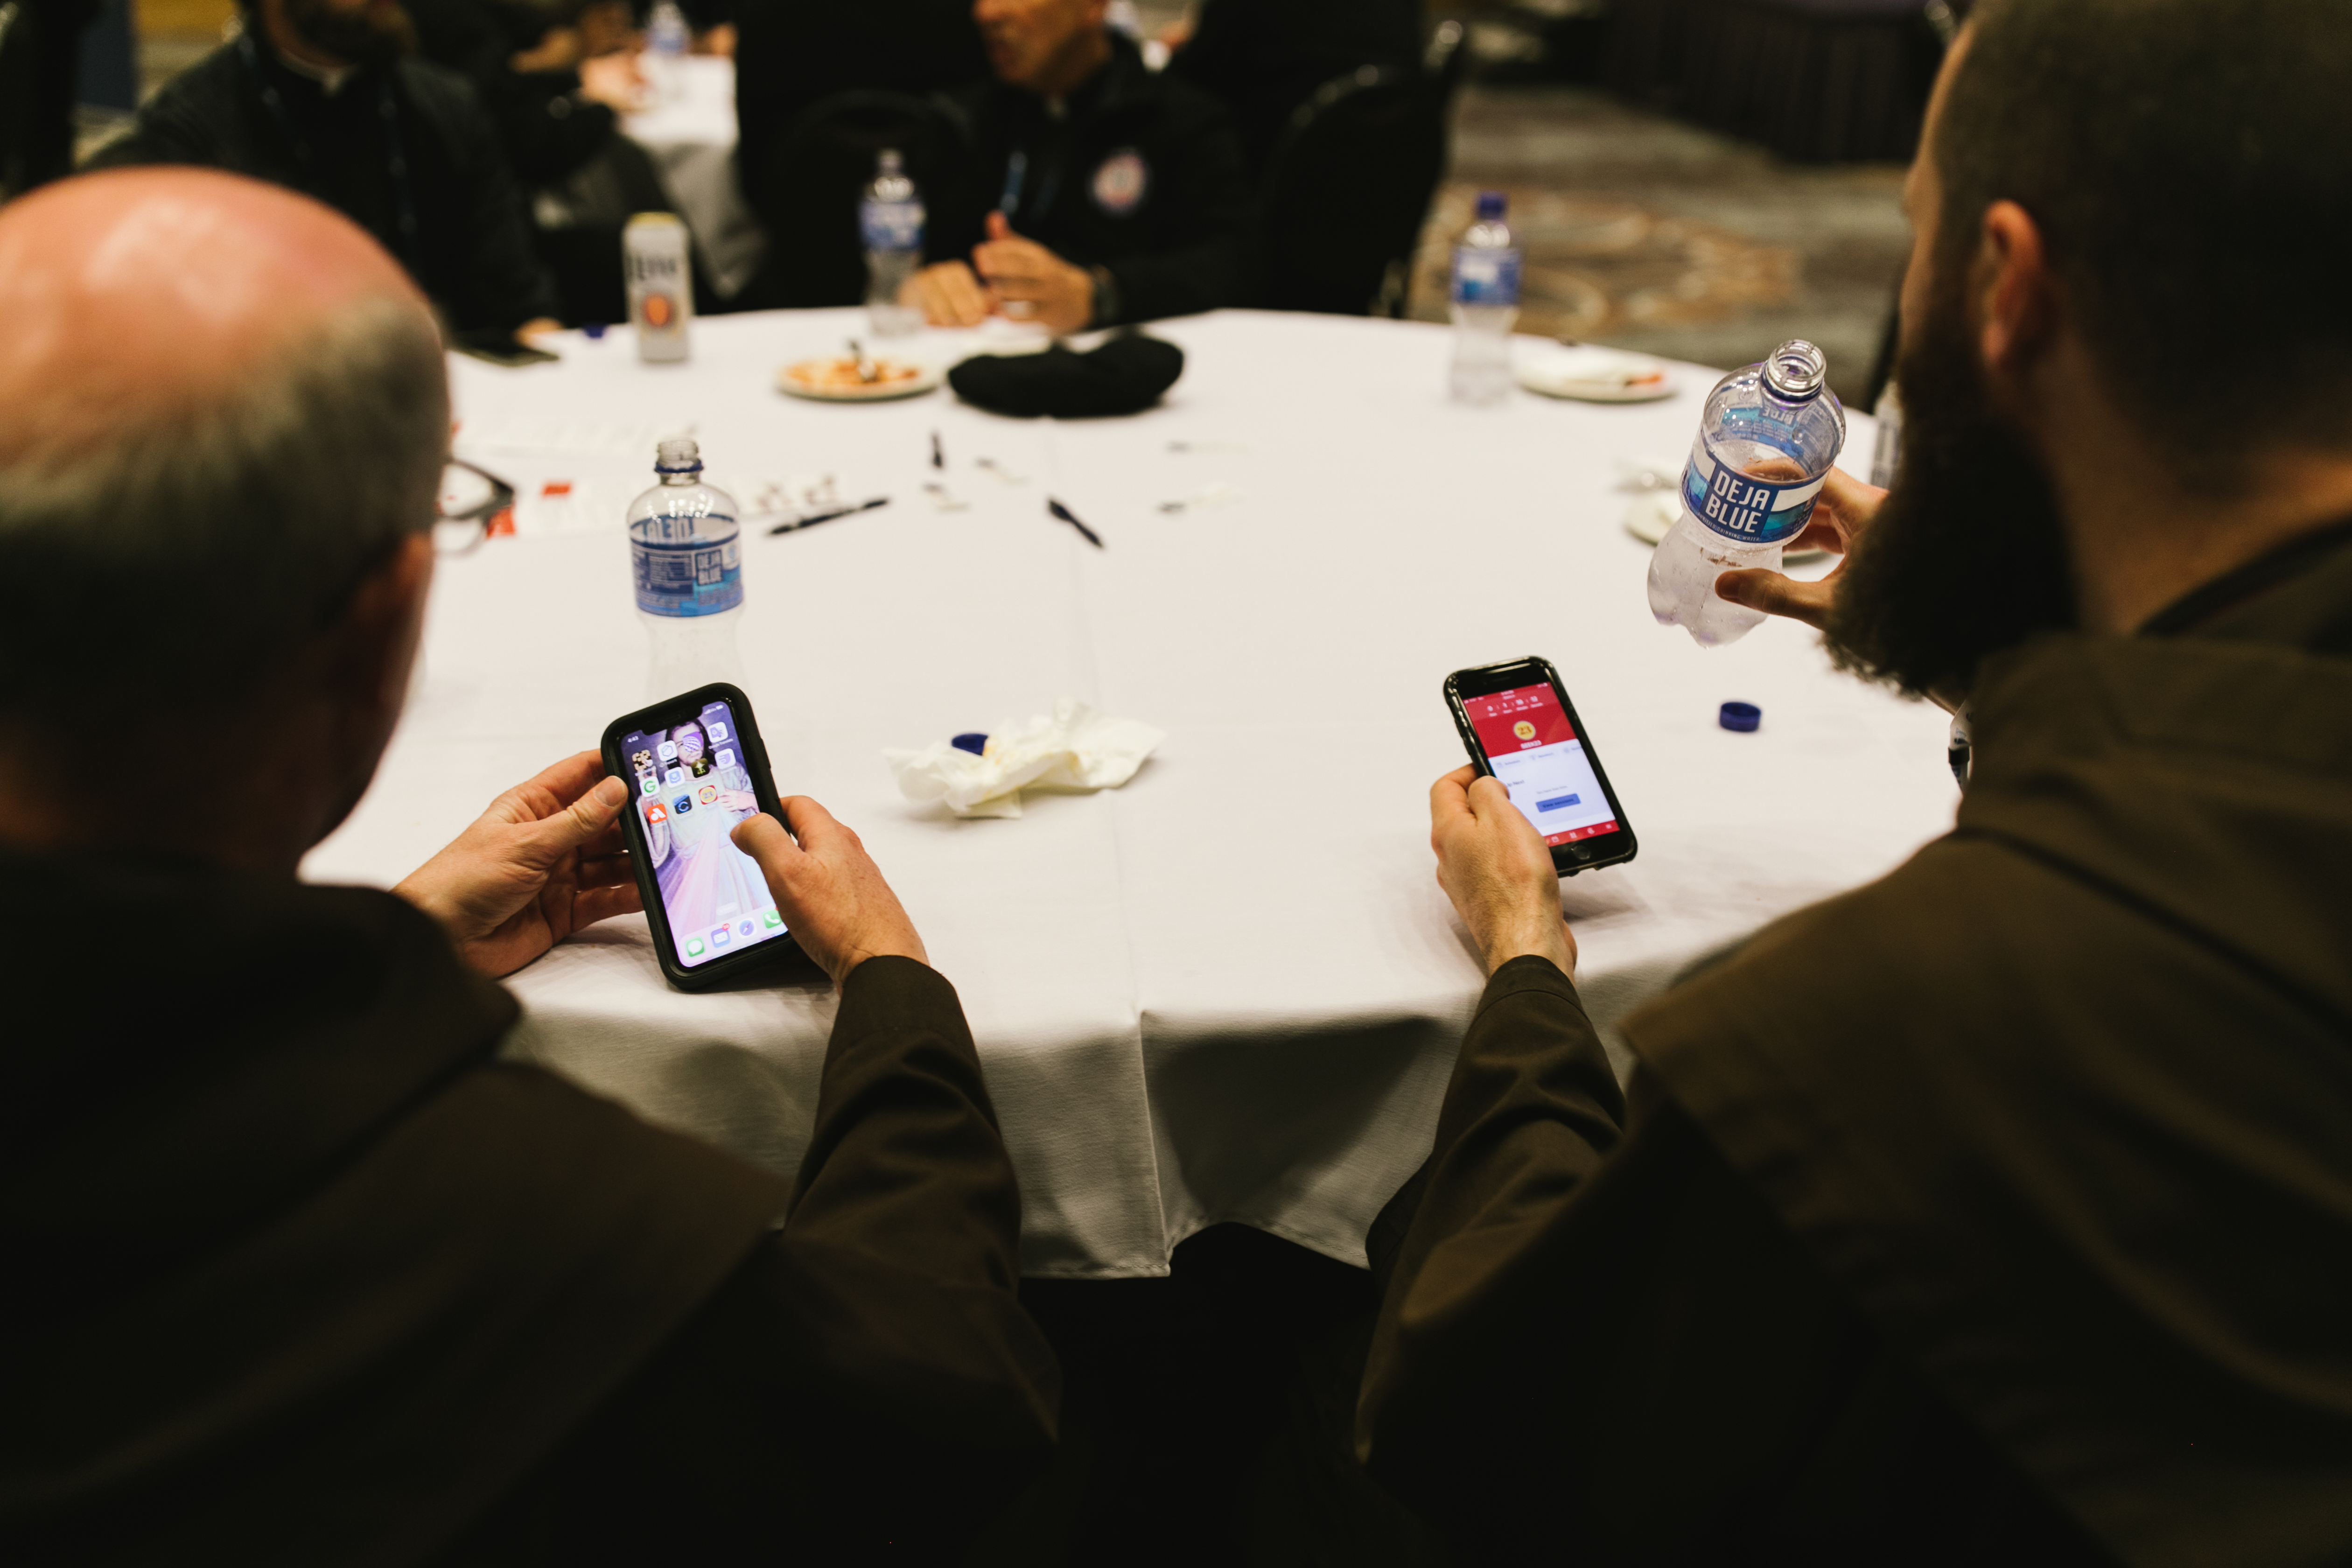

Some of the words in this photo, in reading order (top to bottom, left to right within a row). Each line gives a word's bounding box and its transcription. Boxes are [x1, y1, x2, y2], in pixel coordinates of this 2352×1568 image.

[1714, 470, 1770, 510] DEJA
[1698, 513, 1716, 529] PURIFIED
[1717, 526, 1741, 539] DRINKING
[1706, 493, 1762, 533] BLUE
[1517, 725, 1532, 735] 23
